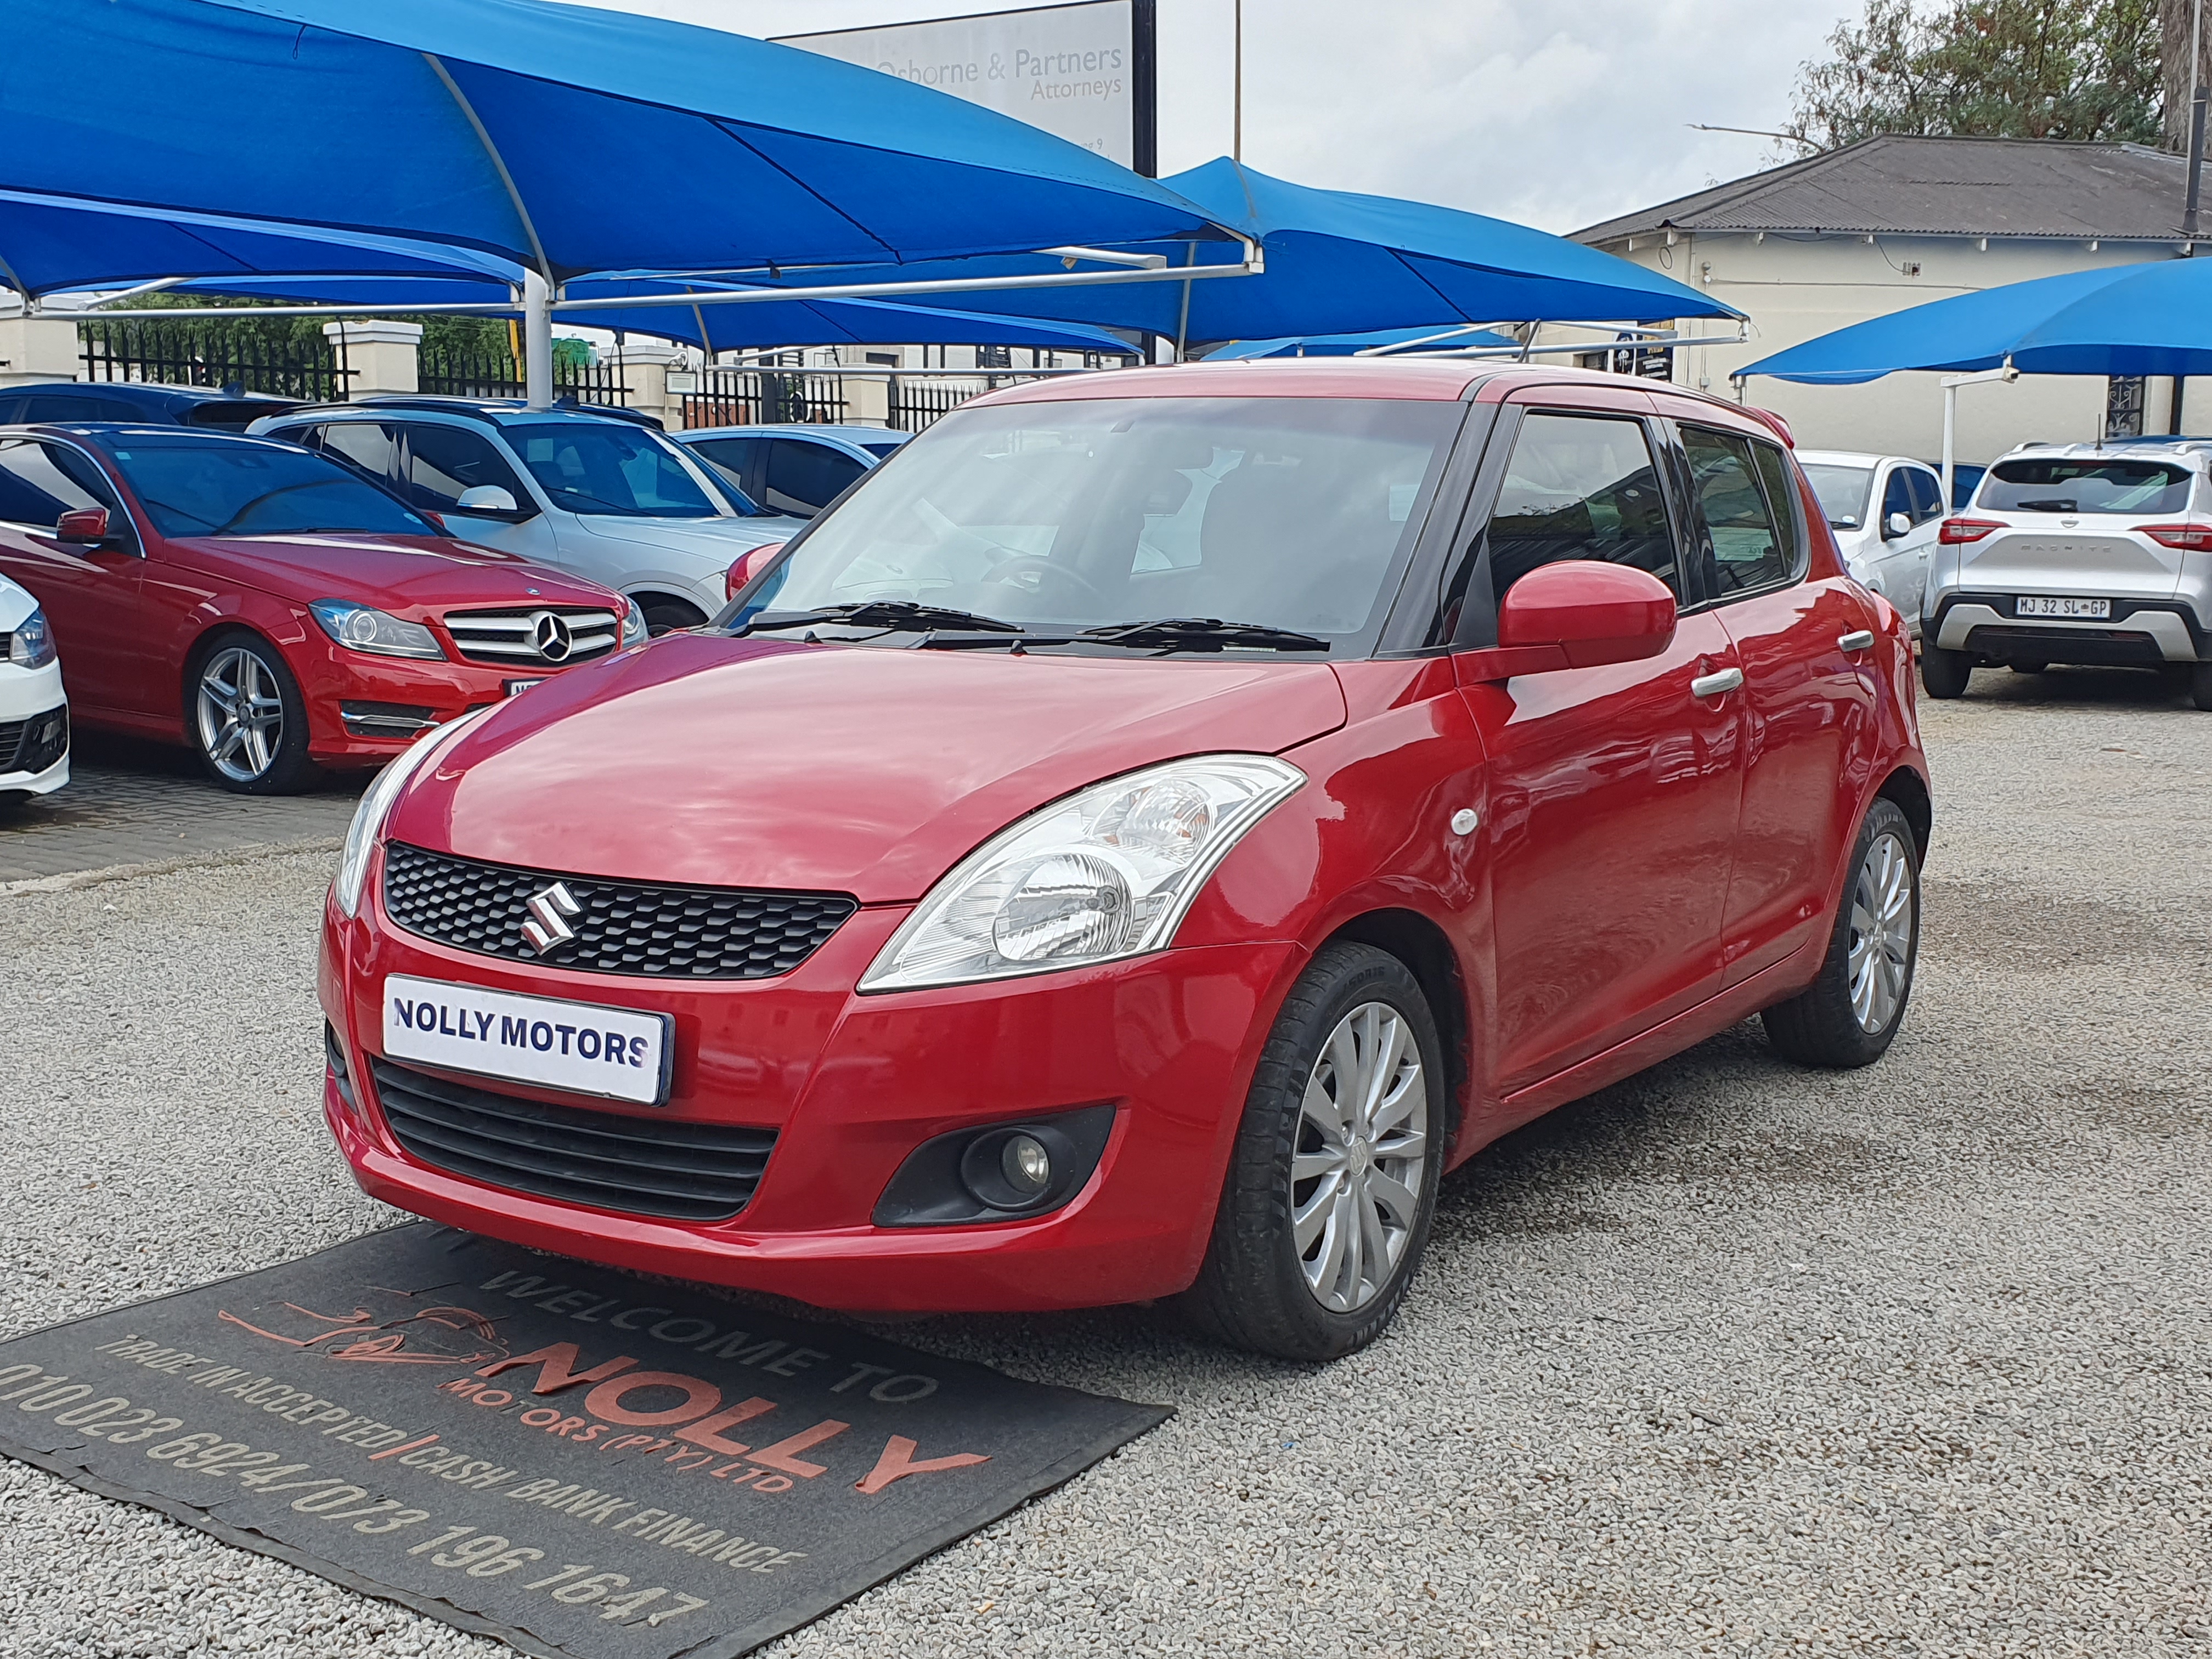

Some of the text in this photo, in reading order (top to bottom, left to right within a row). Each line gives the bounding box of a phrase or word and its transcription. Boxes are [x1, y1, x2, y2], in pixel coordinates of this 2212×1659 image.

[988, 53, 1005, 80] &
[1016, 48, 1121, 77] Partners
[1031, 78, 1121, 101] Attorneys
[2020, 599, 2107, 615] MJ 32 SL GP
[393, 997, 648, 1068] NOLLY MOTORS
[479, 1270, 939, 1402] WELCOME TO
[94, 1334, 216, 1374] TRADE
[186, 1365, 251, 1387] IN
[611, 1507, 809, 1573] FINANCE
[436, 1378, 793, 1492] MOTORS (PTY) LTD
[473, 1341, 992, 1493] NOLLY
[54, 1397, 184, 1443] 023
[407, 1525, 545, 1577] 196
[522, 1564, 709, 1628] 1647
